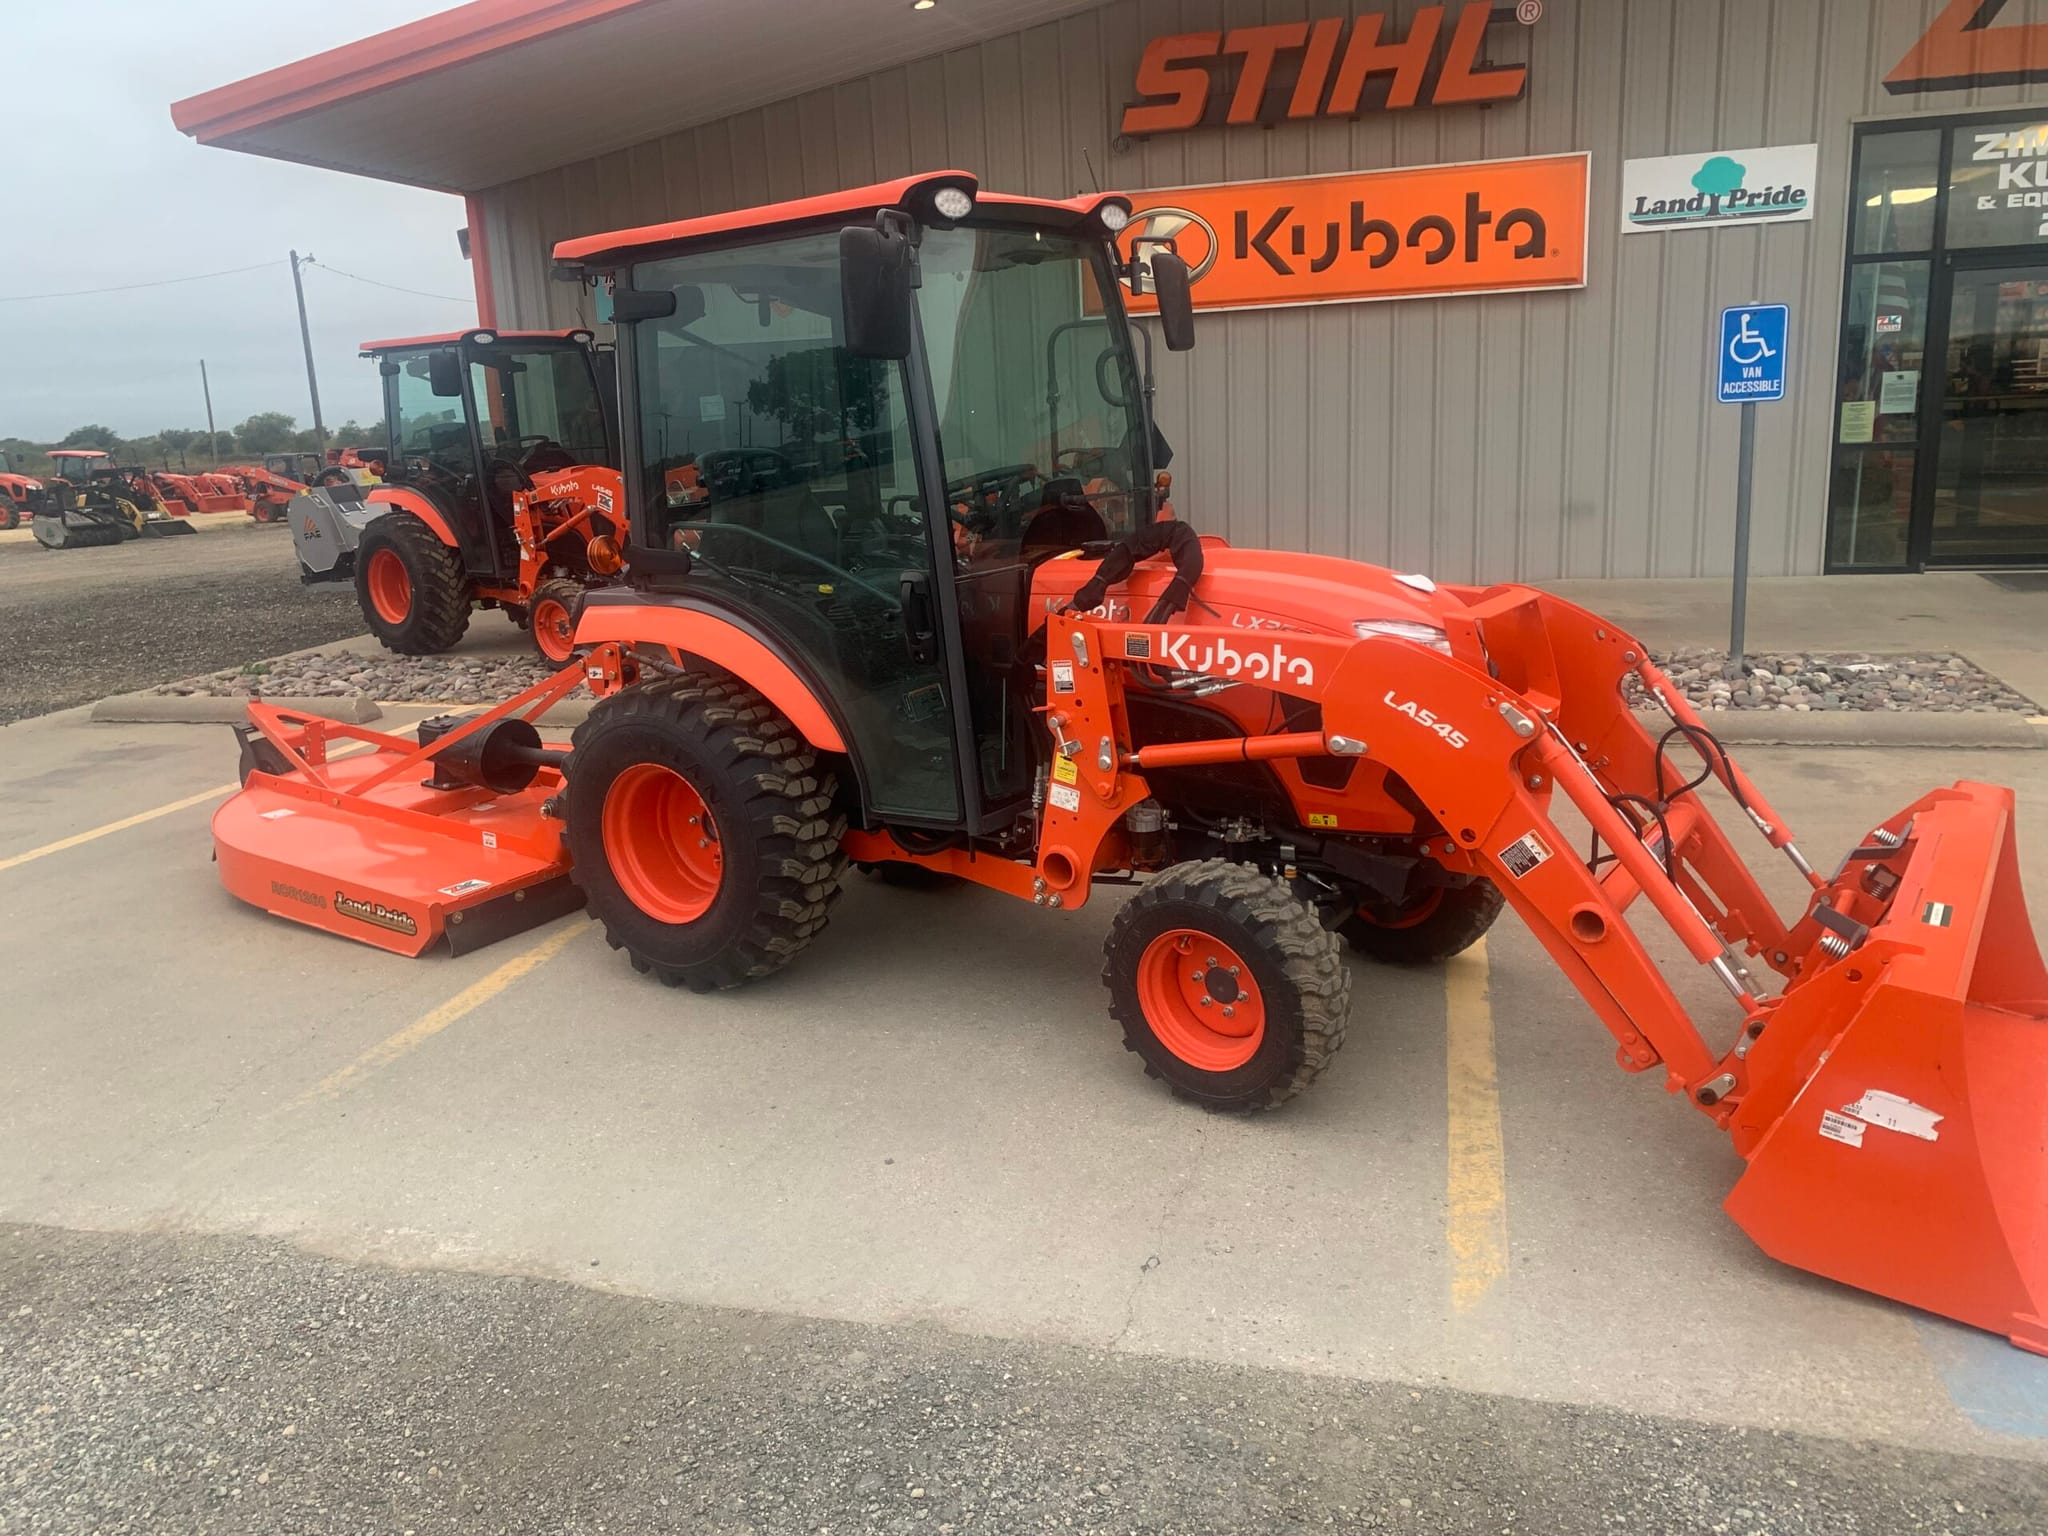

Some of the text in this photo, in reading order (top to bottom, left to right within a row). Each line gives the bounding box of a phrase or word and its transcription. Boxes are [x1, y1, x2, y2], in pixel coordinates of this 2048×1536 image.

[1121, 1, 1527, 133] STIHL
[1634, 185, 1806, 216] Land Pride
[1977, 196, 1997, 210] &
[1234, 191, 1547, 275] Kubota
[1742, 366, 1762, 379] VAN
[1723, 379, 1780, 393] ACCESSIBLE
[550, 480, 579, 496] Kubota
[1160, 631, 1313, 685] Kubota
[1384, 690, 1470, 749] LA545
[336, 892, 371, 913] Land
